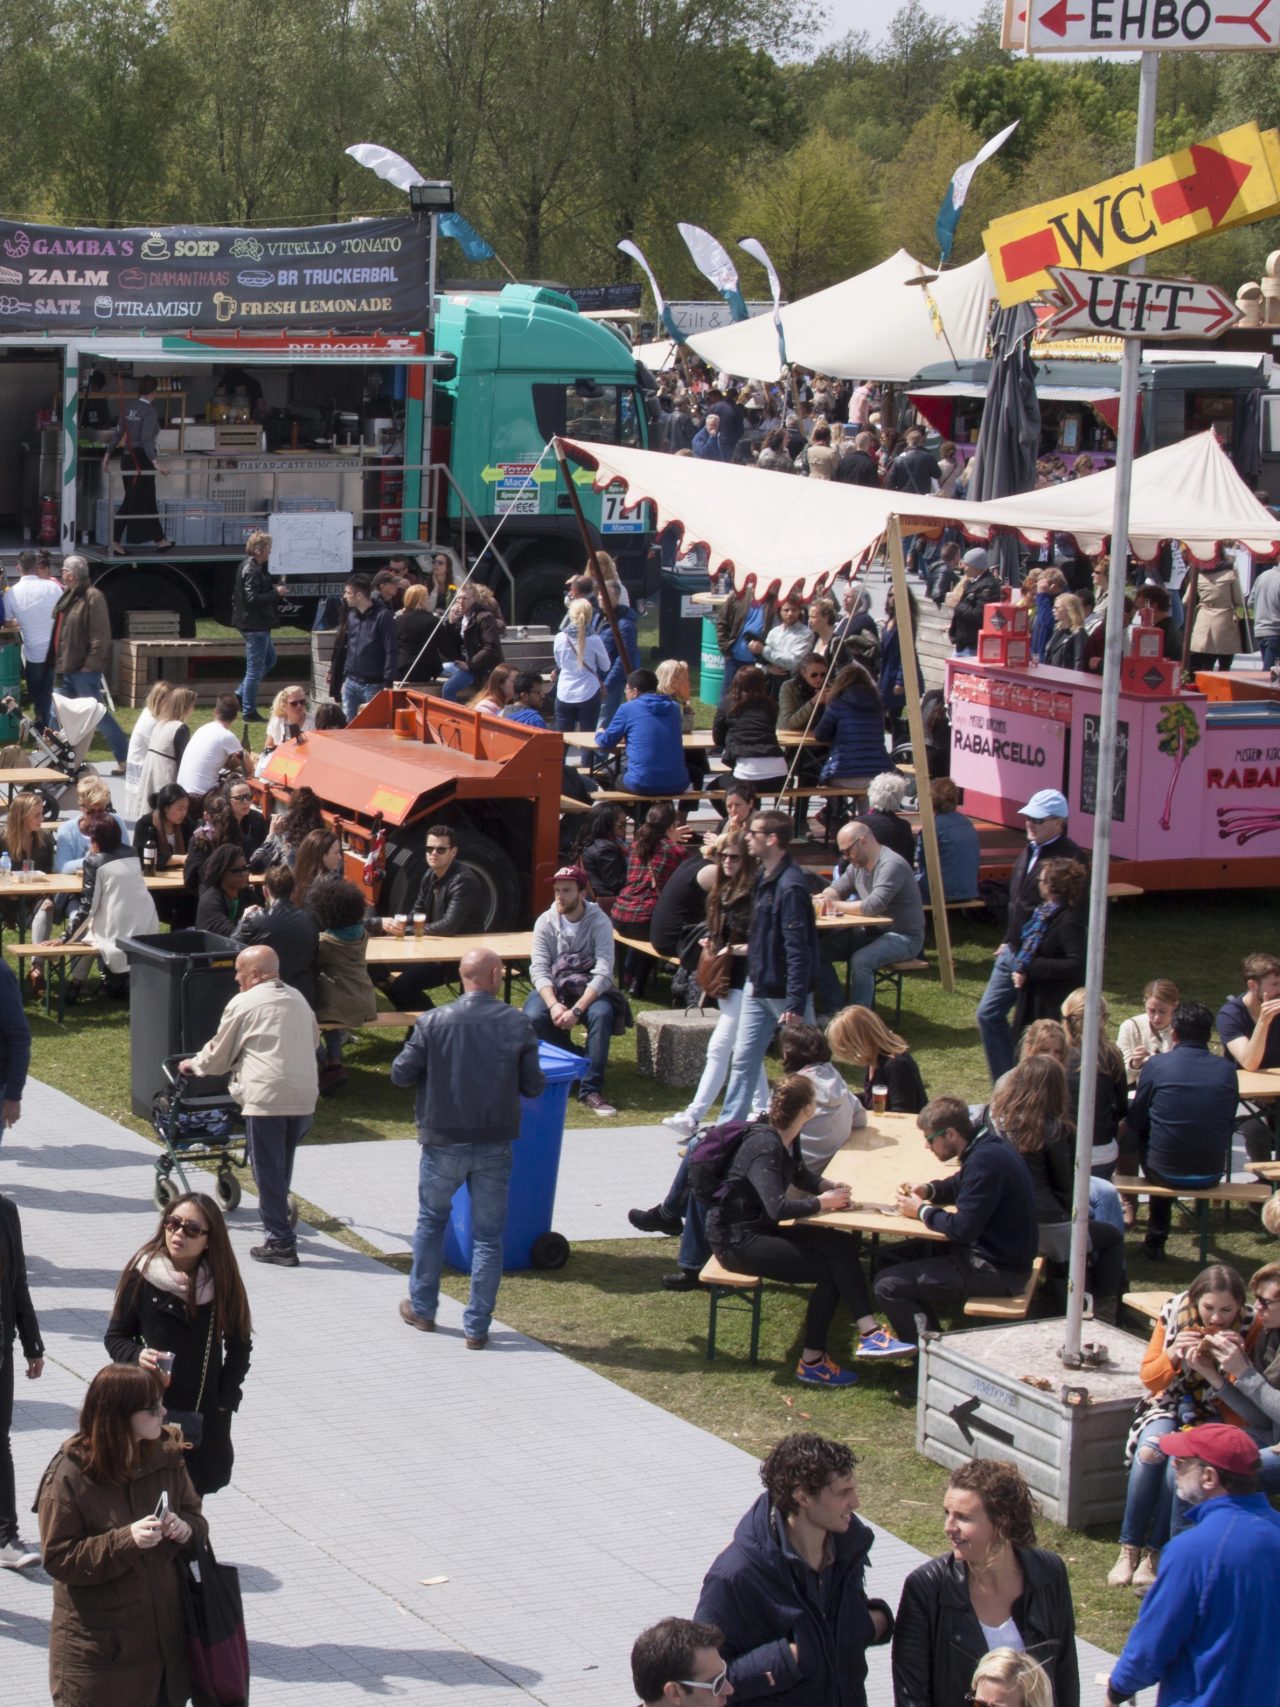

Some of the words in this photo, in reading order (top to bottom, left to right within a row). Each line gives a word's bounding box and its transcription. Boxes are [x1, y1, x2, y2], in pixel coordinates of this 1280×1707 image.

[1090, 0, 1211, 40] EHBO
[1047, 183, 1158, 267] WC
[33, 240, 134, 257] GAMBA'S
[174, 240, 220, 257] SOEP
[266, 241, 337, 256] VITELLO
[341, 236, 402, 254] TONATO
[28, 269, 110, 286] ZALM
[149, 271, 230, 287] DIAMANTHAAS
[277, 270, 299, 286] BR
[303, 267, 399, 285] TRUCKERBAL
[34, 299, 81, 315] SATE
[115, 301, 203, 317] TIRAMISU
[240, 301, 297, 316] FRESH
[300, 298, 393, 314] LEMONADE
[1088, 276, 1194, 331] UIT
[677, 311, 703, 328] Zilt
[708, 311, 722, 328] &
[954, 729, 1046, 768] RABARCELLO
